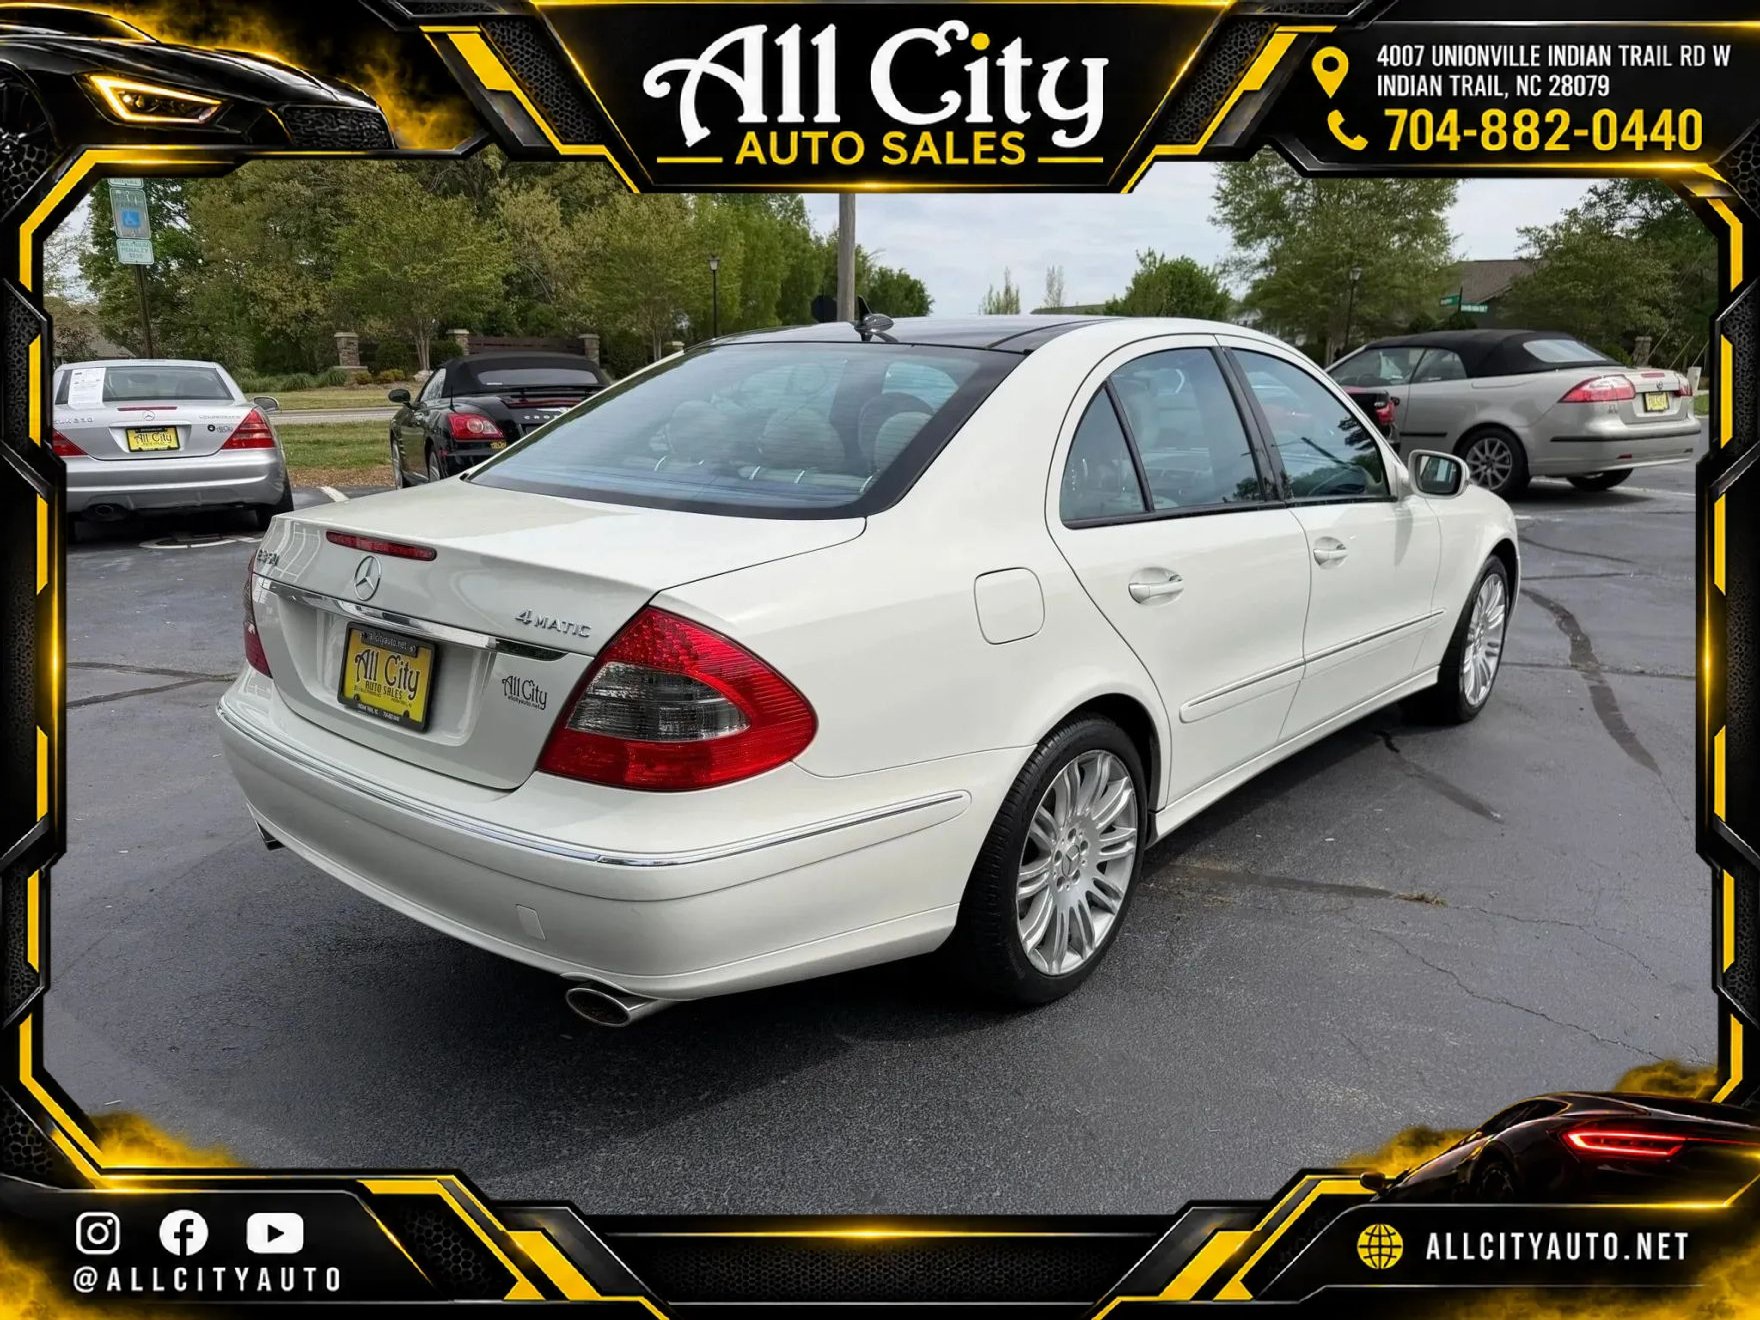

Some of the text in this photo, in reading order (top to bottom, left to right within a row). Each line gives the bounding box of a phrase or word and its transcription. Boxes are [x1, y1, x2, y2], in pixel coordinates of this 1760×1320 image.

[152, 433, 172, 443] City
[355, 649, 420, 701] All City
[365, 680, 381, 693] AUTO
[383, 686, 402, 699] SALES
[502, 675, 547, 710] All City
